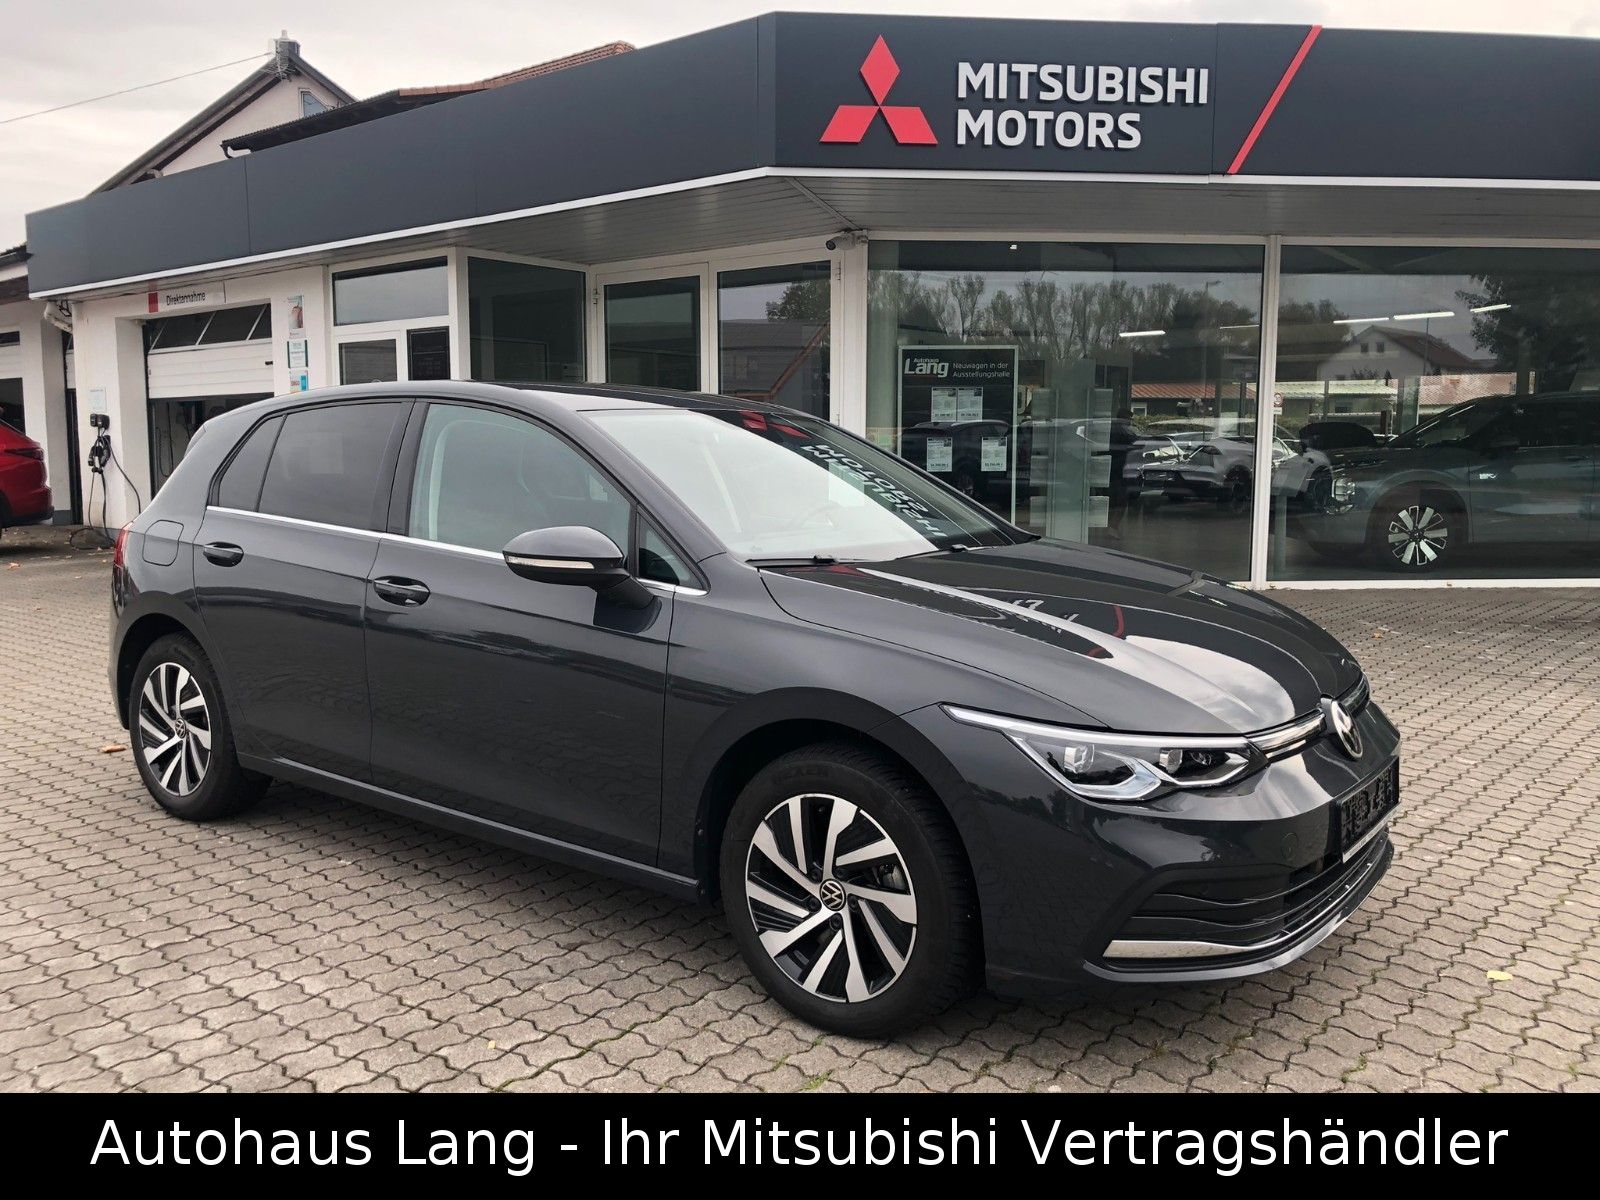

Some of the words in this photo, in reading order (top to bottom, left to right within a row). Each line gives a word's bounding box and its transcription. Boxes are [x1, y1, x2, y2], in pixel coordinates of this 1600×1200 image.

[957, 62, 1209, 104] MITSUBISHI
[956, 109, 1142, 149] MOTORS
[166, 291, 206, 305] Direktannahme
[904, 358, 949, 378] Lang
[952, 362, 988, 370] Neuwagen
[952, 371, 1011, 379] Ausstellungshalle
